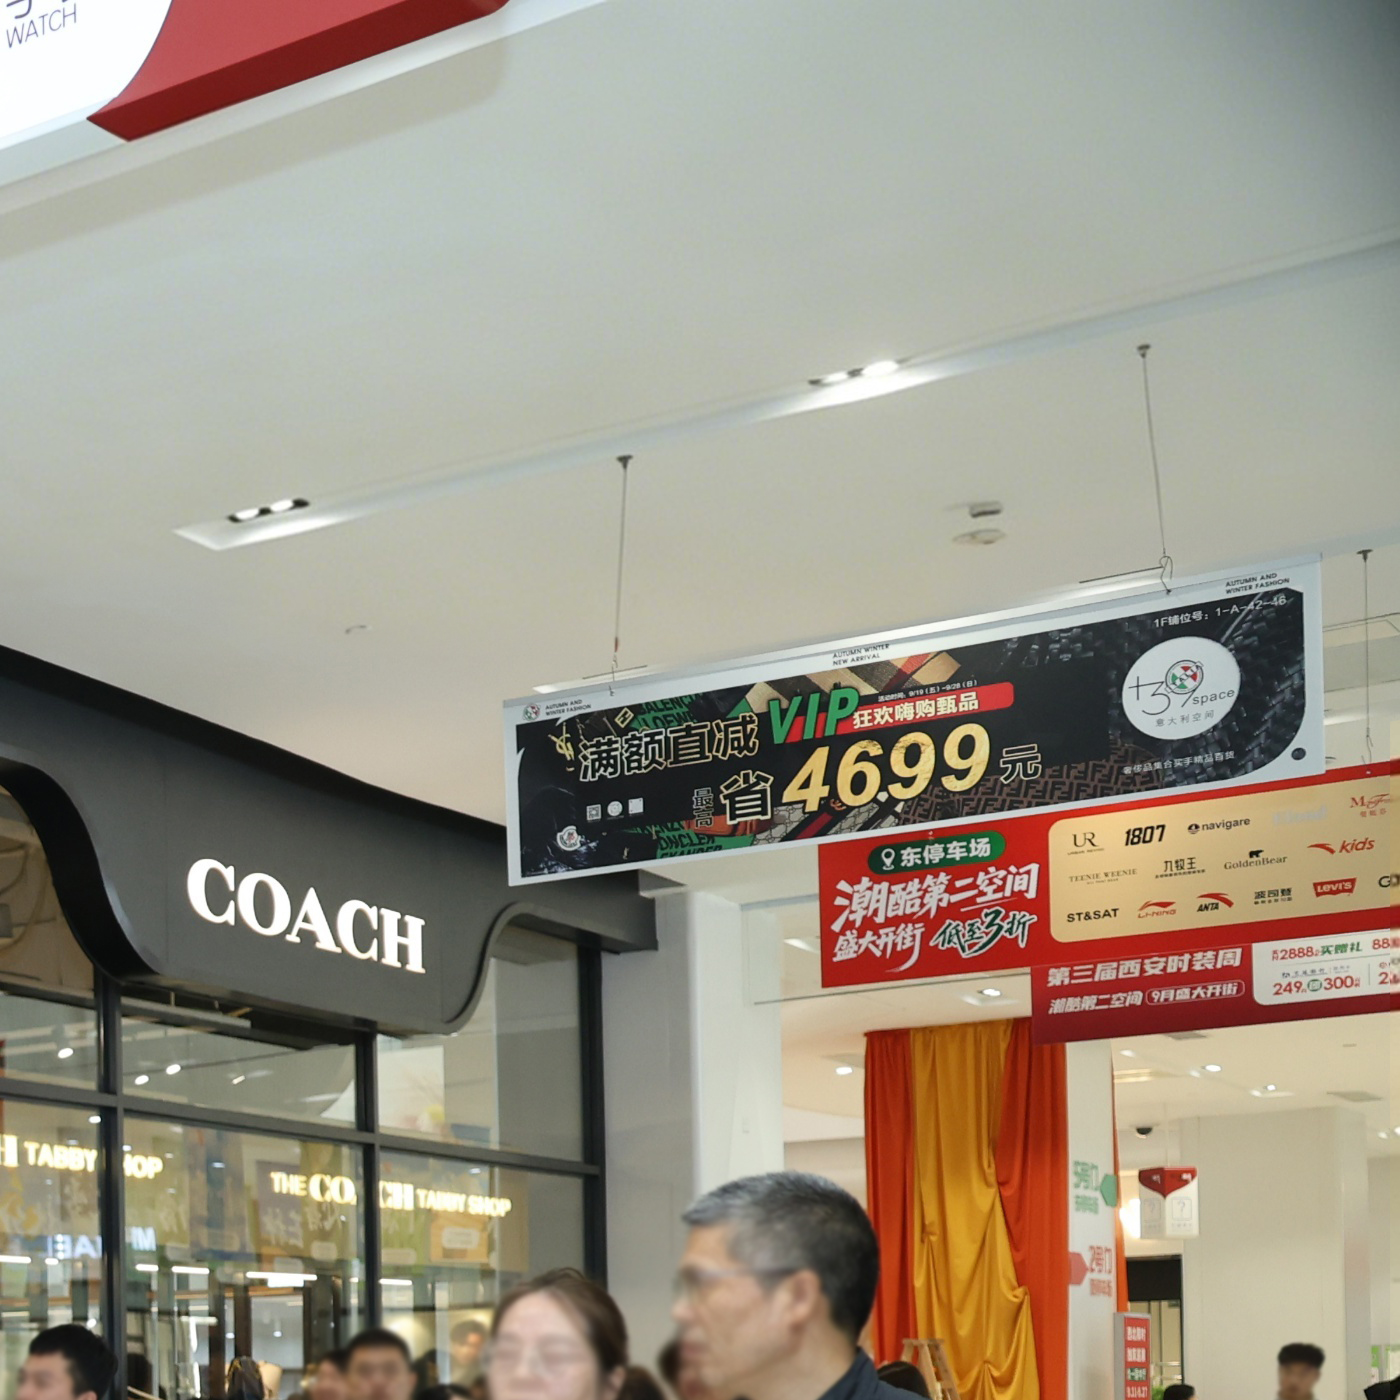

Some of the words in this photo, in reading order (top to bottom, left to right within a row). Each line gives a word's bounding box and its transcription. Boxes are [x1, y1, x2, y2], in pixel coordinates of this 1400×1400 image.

[6, 3, 77, 48] WATCH
[1225, 577, 1258, 588] AUTUMN
[1259, 572, 1278, 581] AND
[1225, 584, 1253, 595] WINTER
[1255, 578, 1290, 589] FASHION
[833, 648, 863, 658] AUTUMN
[864, 643, 890, 653] WINTER
[850, 653, 880, 664] ARRIVAL
[545, 702, 569, 710] AUTUMN
[1192, 689, 1235, 706] space
[545, 708, 566, 716] WINTER
[566, 704, 592, 712] FASHION
[768, 687, 860, 744] VIP
[853, 691, 979, 729] 狂欢嗨购甄品
[578, 712, 760, 782] 满额直减
[719, 769, 774, 826] 省
[782, 723, 991, 813] 4699
[1000, 743, 1042, 785] 元
[692, 787, 715, 829] 最高
[1202, 816, 1251, 832] navigare
[1072, 832, 1099, 848] UR
[1124, 824, 1167, 847] 1807
[1339, 837, 1375, 854] kids
[900, 837, 991, 867] 东停车场
[1163, 857, 1197, 872] 九牧王
[1223, 856, 1288, 870] GoldenBear
[1069, 869, 1102, 883] TEENIE
[1103, 868, 1138, 880] WEENIE
[830, 862, 1040, 933] 潮酷第二空间
[186, 858, 426, 974] COACH
[1066, 908, 1120, 923] ST&SAT
[1196, 903, 1220, 913] ANTA
[832, 922, 925, 973] 盛大开街
[929, 907, 1038, 958] 低至3折
[1046, 948, 1243, 988] 第三届西安时装周
[1048, 990, 1144, 1015] 潮酷第二空间
[1151, 982, 1239, 1004] 9月盛大开街
[23, 1140, 98, 1173] TABBY
[270, 1171, 308, 1197] THE
[308, 1173, 415, 1212] COCH
[467, 1194, 512, 1218] SHOP
